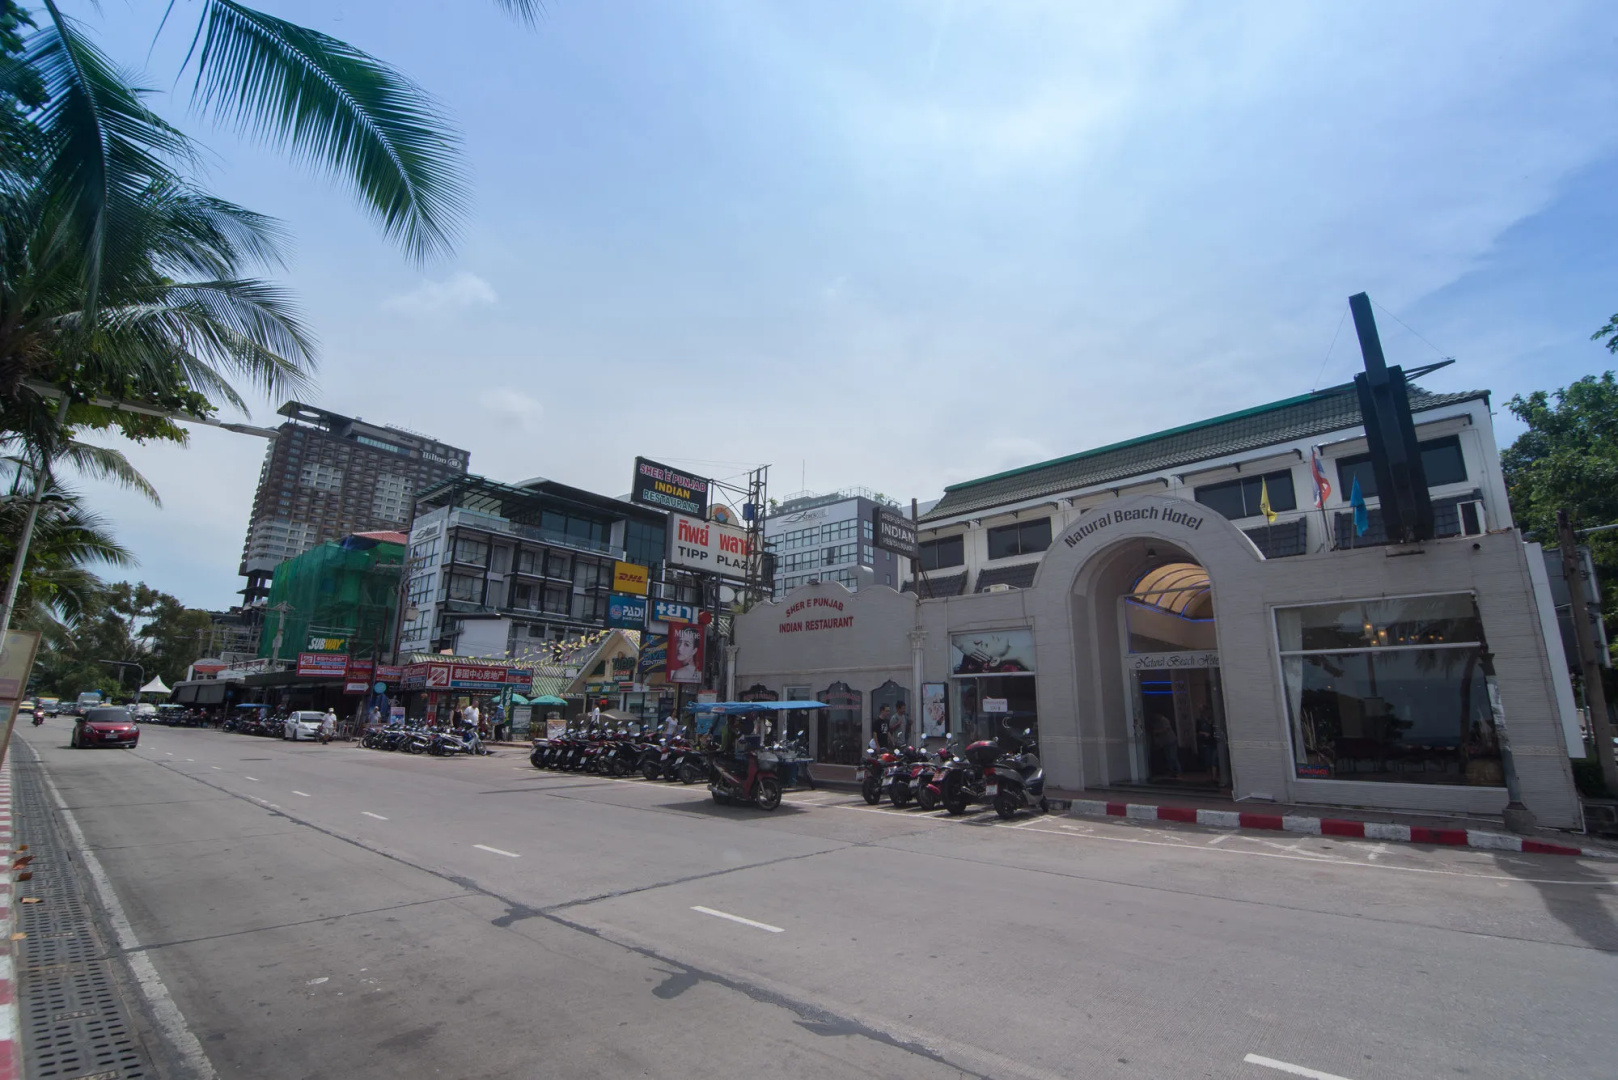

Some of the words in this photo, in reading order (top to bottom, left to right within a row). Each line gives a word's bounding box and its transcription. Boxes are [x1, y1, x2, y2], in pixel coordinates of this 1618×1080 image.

[422, 451, 447, 465] Hilton
[640, 464, 664, 482] SHER
[672, 475, 707, 493] PUNJAB
[654, 480, 691, 499] INDIAN
[642, 488, 700, 514] RESTAURANT
[677, 519, 710, 547] ทิพย์
[881, 522, 915, 544] INDIAN
[1064, 512, 1112, 548] Natural
[1113, 506, 1159, 524] Beach
[1161, 507, 1204, 531] Hotel
[677, 545, 709, 561] TIPP
[618, 572, 644, 584] DHL
[622, 605, 644, 618] PADI
[785, 600, 805, 618] SHER
[806, 598, 812, 608] E
[813, 597, 844, 612] PUNJAB
[779, 621, 803, 634] INDIAN
[805, 616, 854, 632] RESTAURANT
[308, 637, 345, 651] SUBWAY
[1135, 656, 1165, 669] Natural
[1166, 655, 1195, 667] Beach
[1197, 654, 1220, 666] Hote
